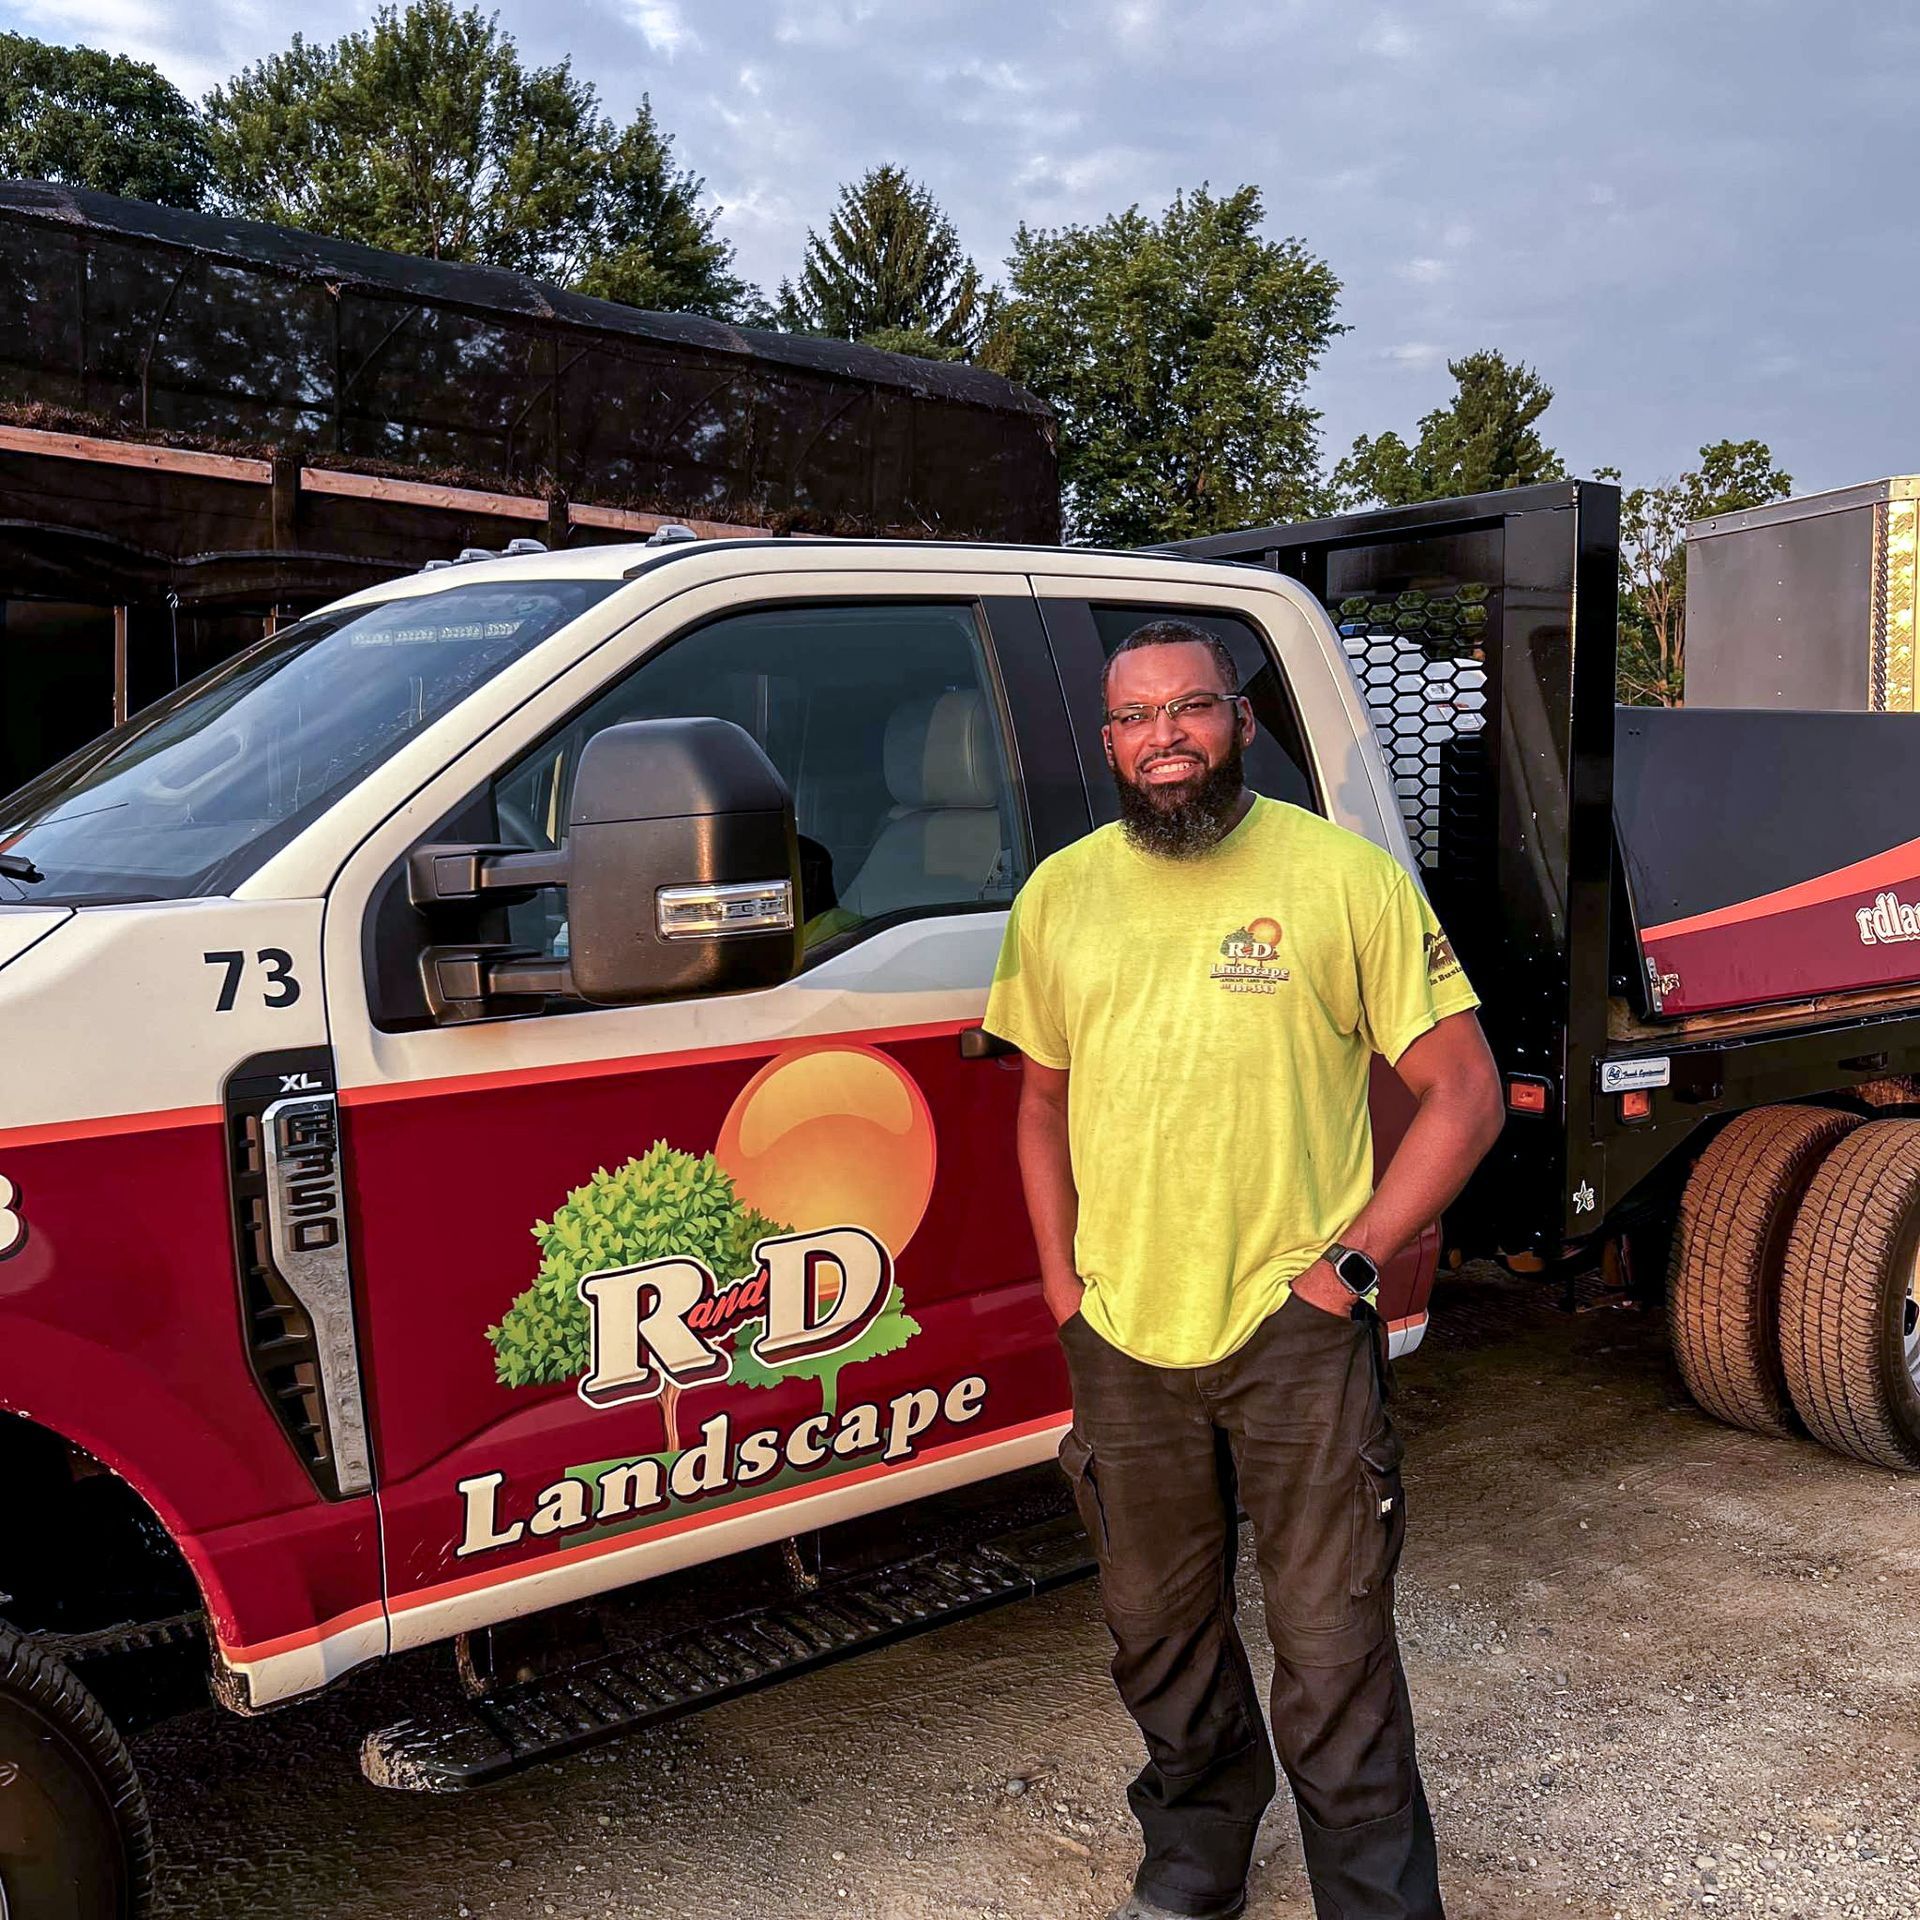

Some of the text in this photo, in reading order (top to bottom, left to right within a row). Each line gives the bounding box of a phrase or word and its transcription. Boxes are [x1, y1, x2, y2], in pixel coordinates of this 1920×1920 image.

[203, 947, 301, 1012] 73
[1210, 963, 1290, 979] Landscape
[278, 1072, 323, 1093] XL
[579, 1225, 892, 1406] R and D
[456, 1376, 988, 1557] Landscape
